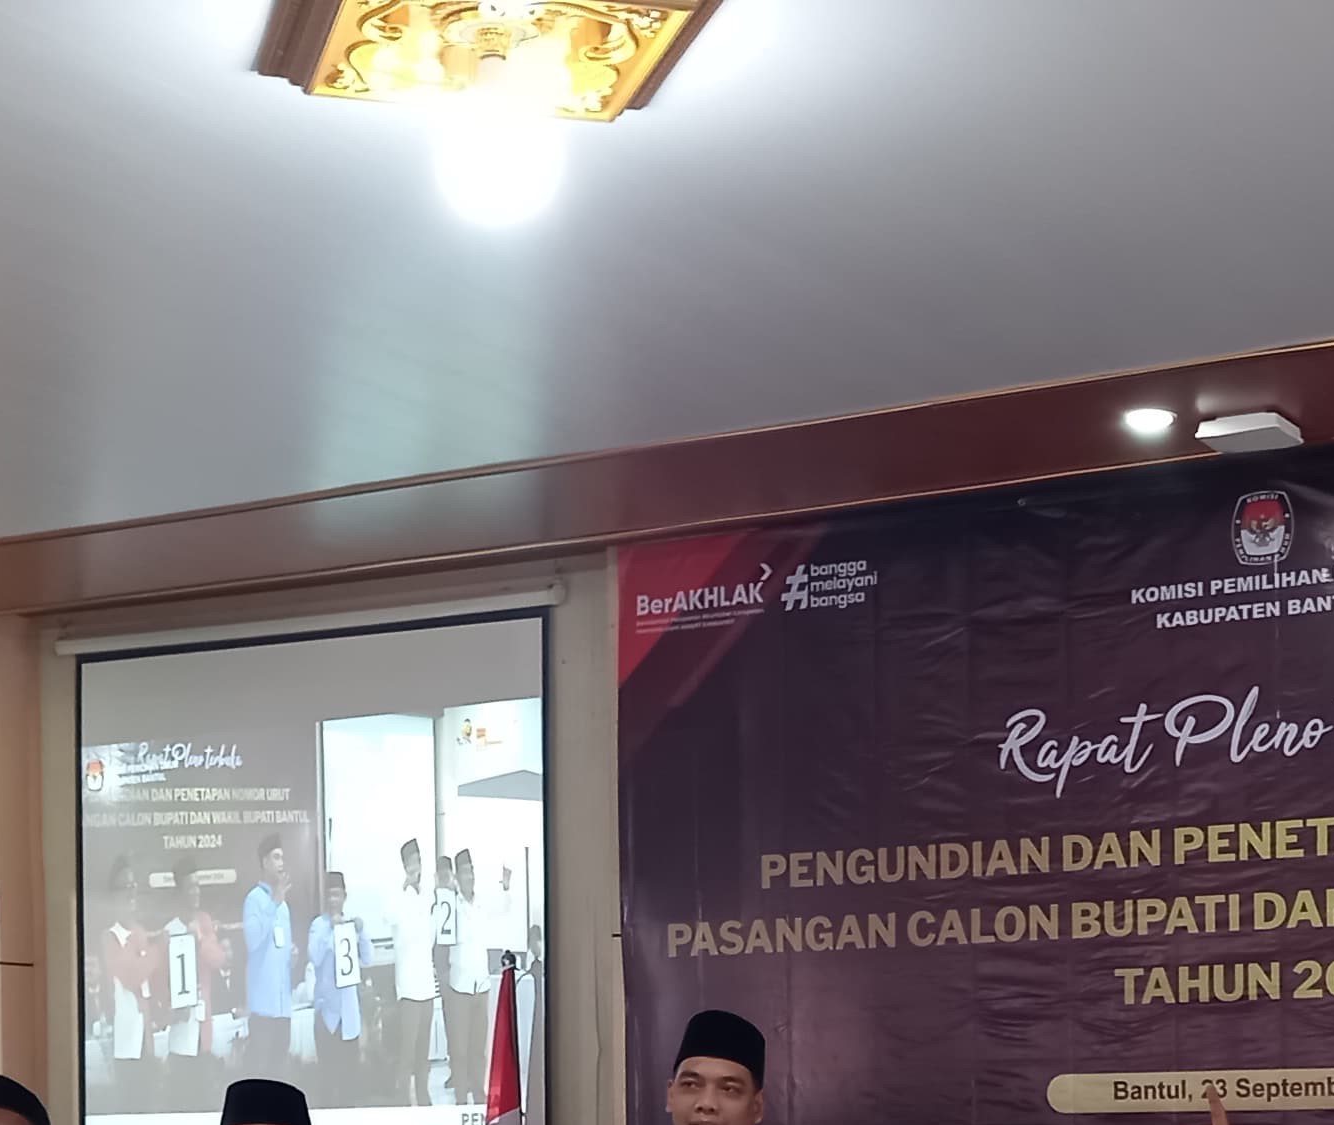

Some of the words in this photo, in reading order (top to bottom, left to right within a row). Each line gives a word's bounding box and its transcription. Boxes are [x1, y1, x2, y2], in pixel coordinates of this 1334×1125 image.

[810, 560, 867, 577] bangga
[810, 571, 878, 593] melayani
[1131, 580, 1204, 604] KOMISI
[1210, 567, 1330, 596] PEMILIHAN
[636, 581, 764, 617] BerAKHLAK
[810, 592, 866, 609] bangsa
[1156, 601, 1281, 629] KABUPATEN
[997, 703, 1164, 799] Rapat
[1164, 686, 1334, 768] Pleno
[197, 834, 223, 848] 2024
[760, 835, 1052, 890] PENGUNDIAN
[1063, 829, 1161, 873] DAN
[667, 913, 896, 958] PASANGAN
[906, 903, 1059, 948] CALON
[1070, 895, 1246, 940] BUPATI
[176, 952, 190, 997] 1
[340, 938, 354, 977] 3
[1115, 961, 1282, 1006] TAHUN
[1113, 1079, 1194, 1103] Bantul,
